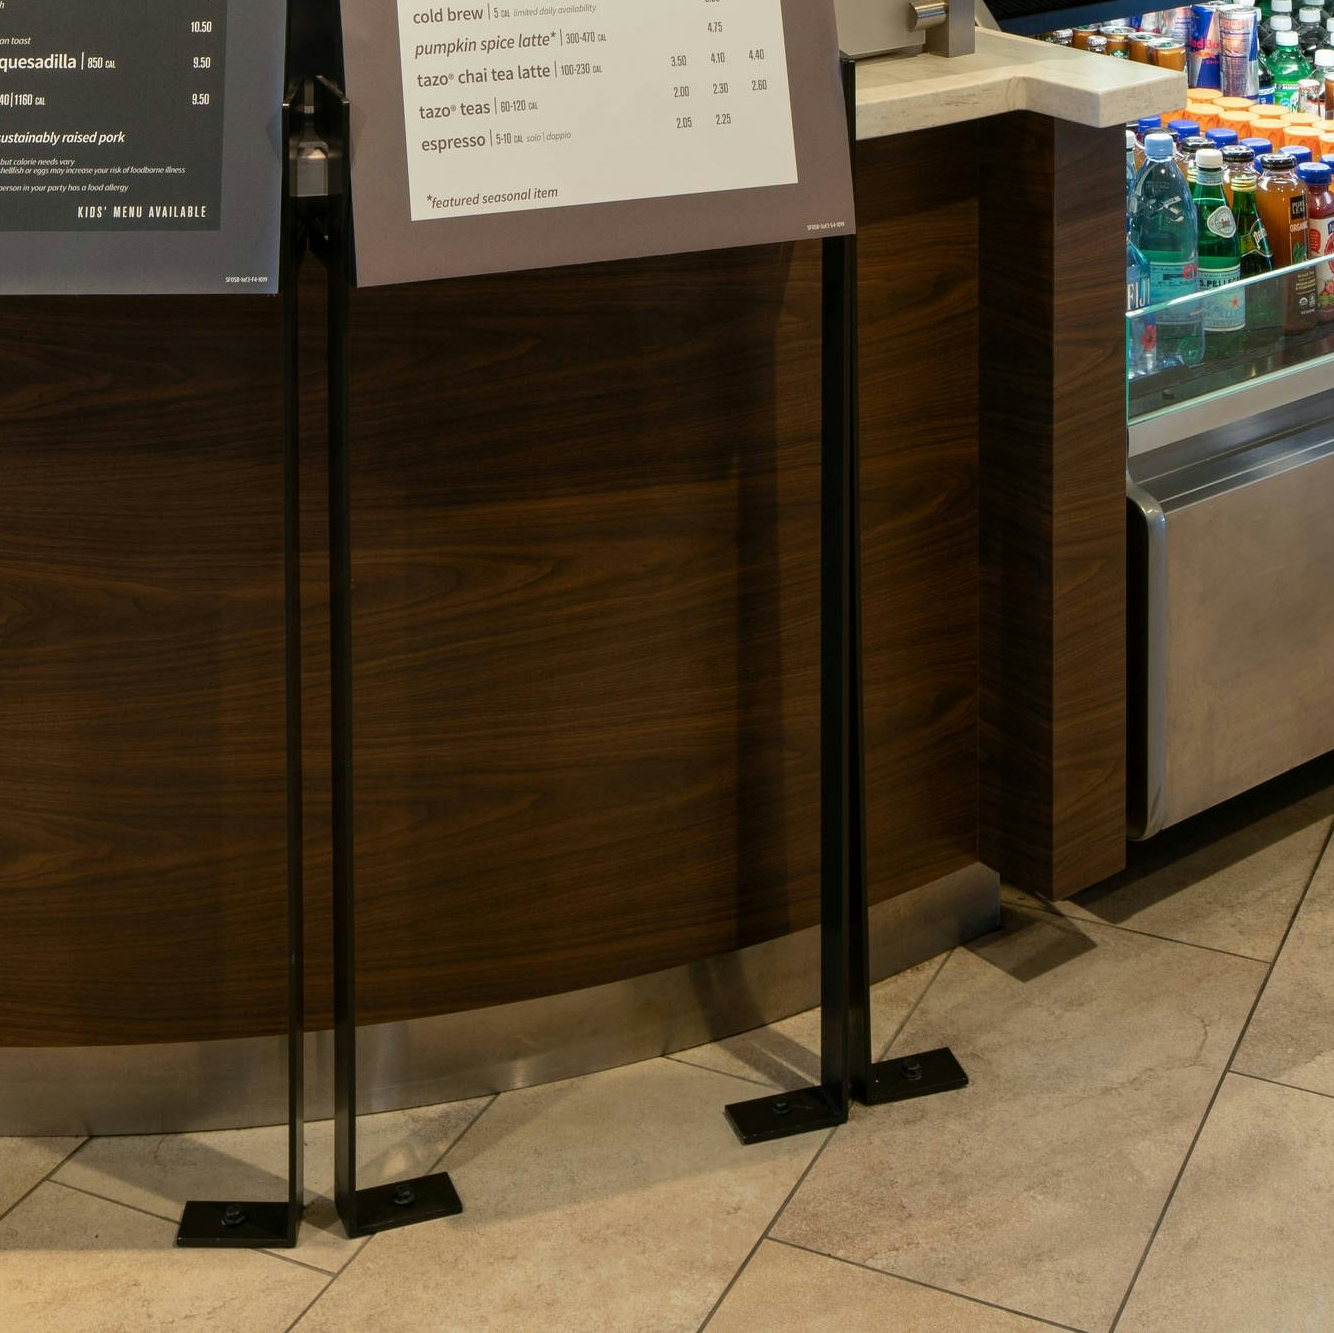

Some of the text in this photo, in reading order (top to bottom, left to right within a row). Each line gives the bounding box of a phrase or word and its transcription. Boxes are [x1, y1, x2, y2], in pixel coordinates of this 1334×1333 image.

[413, 7, 483, 24] cold brew
[415, 37, 477, 60] pumpkin
[480, 35, 515, 54] spice
[458, 67, 487, 84] chai
[491, 68, 514, 82] tea
[517, 65, 550, 80] latte
[61, 131, 98, 143] raised
[98, 131, 125, 146] pork
[421, 135, 486, 154] espresso
[482, 188, 531, 204] seasonal
[533, 188, 558, 199] item
[113, 206, 142, 218] MENU
[148, 205, 206, 218] AVAILABLE
